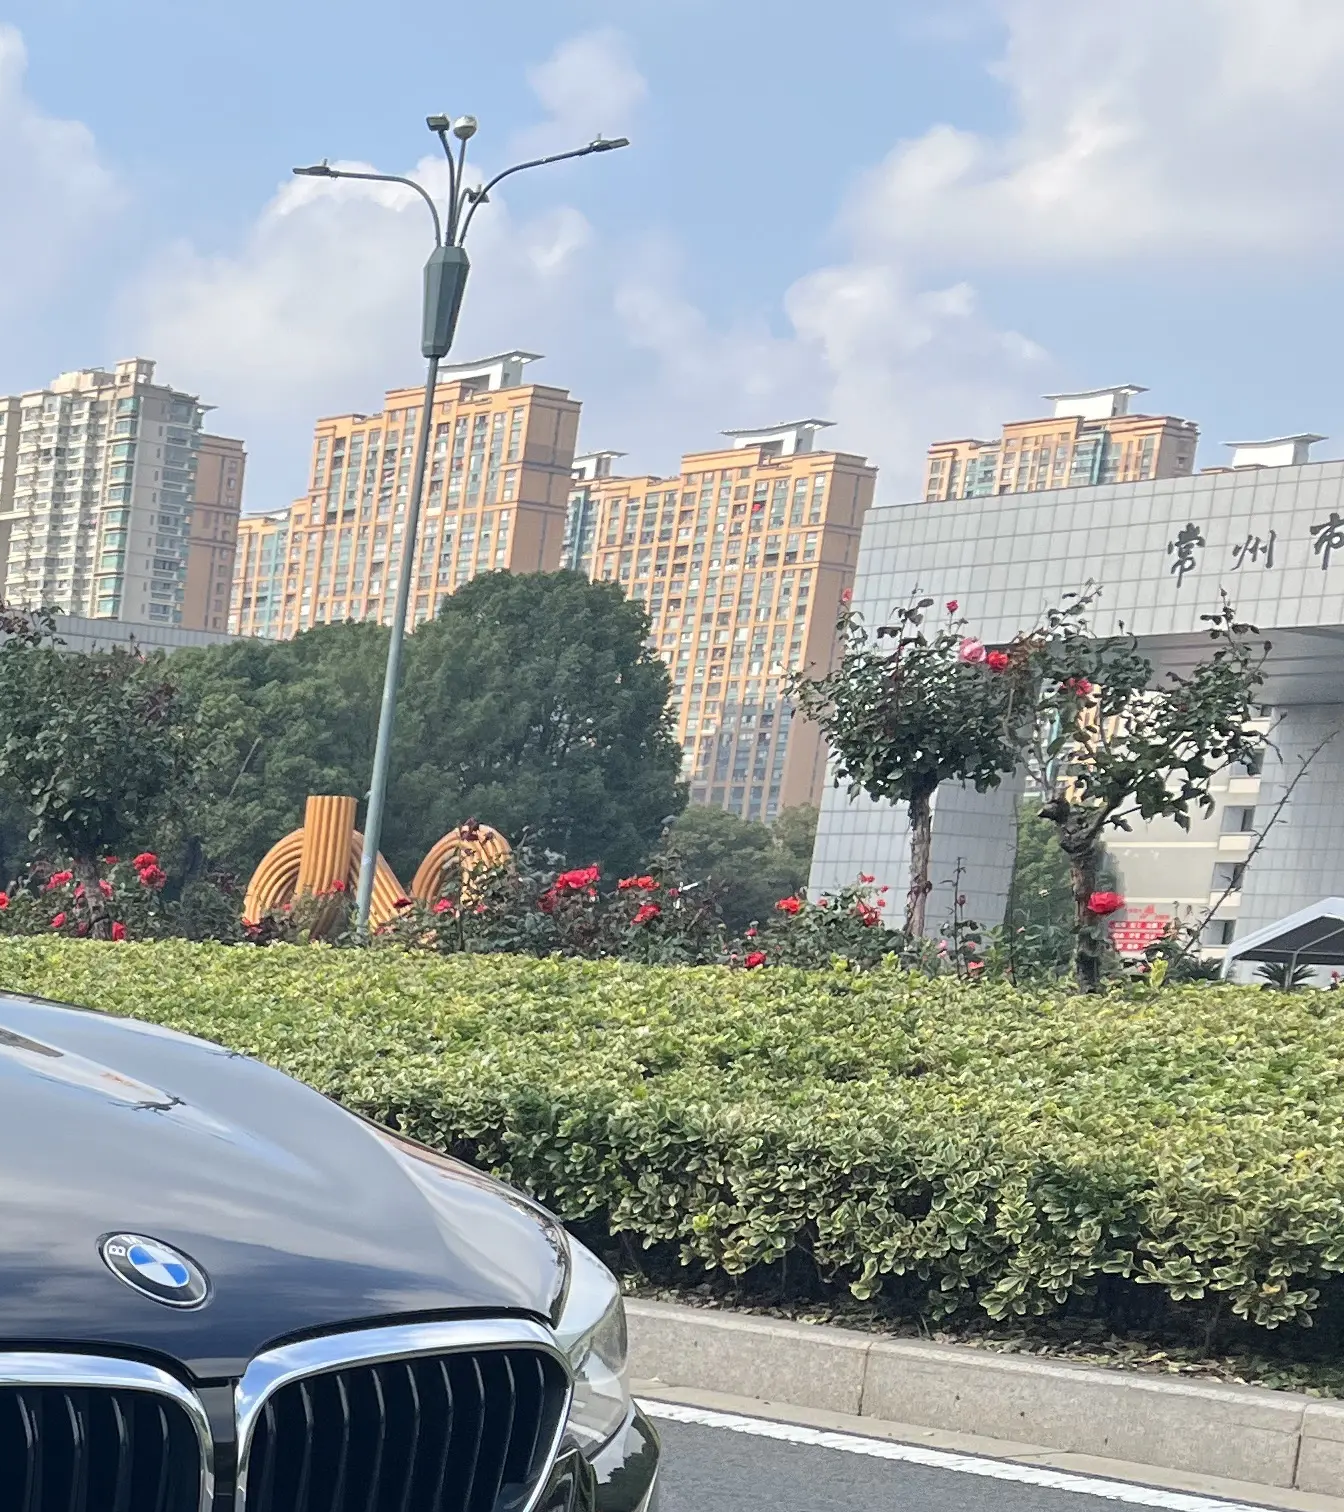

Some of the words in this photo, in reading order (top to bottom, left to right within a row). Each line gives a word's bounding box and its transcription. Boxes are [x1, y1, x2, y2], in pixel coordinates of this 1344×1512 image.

[1167, 511, 1344, 589] 常州市
[108, 1235, 175, 1257] BMW
